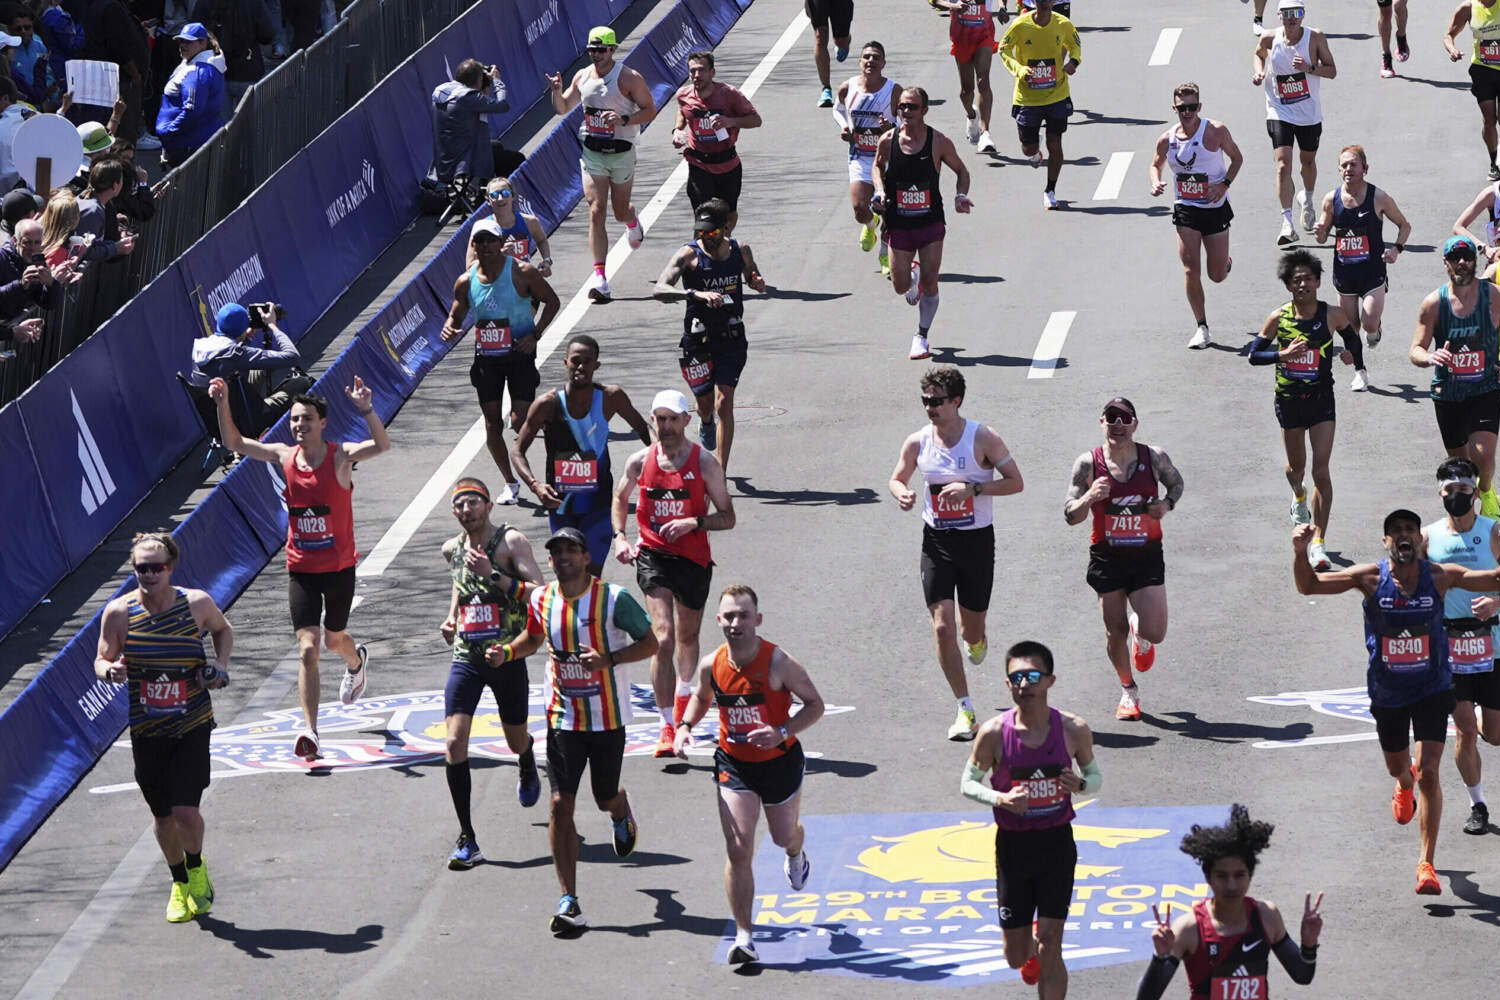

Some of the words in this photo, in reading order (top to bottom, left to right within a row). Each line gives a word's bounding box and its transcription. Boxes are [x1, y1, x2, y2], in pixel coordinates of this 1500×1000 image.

[1181, 181, 1203, 194] 5234
[480, 328, 505, 342] 5997
[1452, 353, 1479, 367] 4273
[561, 462, 590, 476] 2708
[654, 501, 684, 516] 3842
[297, 517, 326, 533] 4028
[1111, 516, 1141, 530] 7412
[1387, 638, 1422, 654] 6340
[1453, 638, 1485, 655] 4466
[146, 682, 180, 699] 5274
[727, 707, 760, 724] 3265
[755, 890, 908, 909] 129TH
[919, 884, 1208, 906] BOTON
[755, 900, 1206, 925] MARAON
[897, 922, 964, 936] OF
[1221, 978, 1259, 1000] 1782
